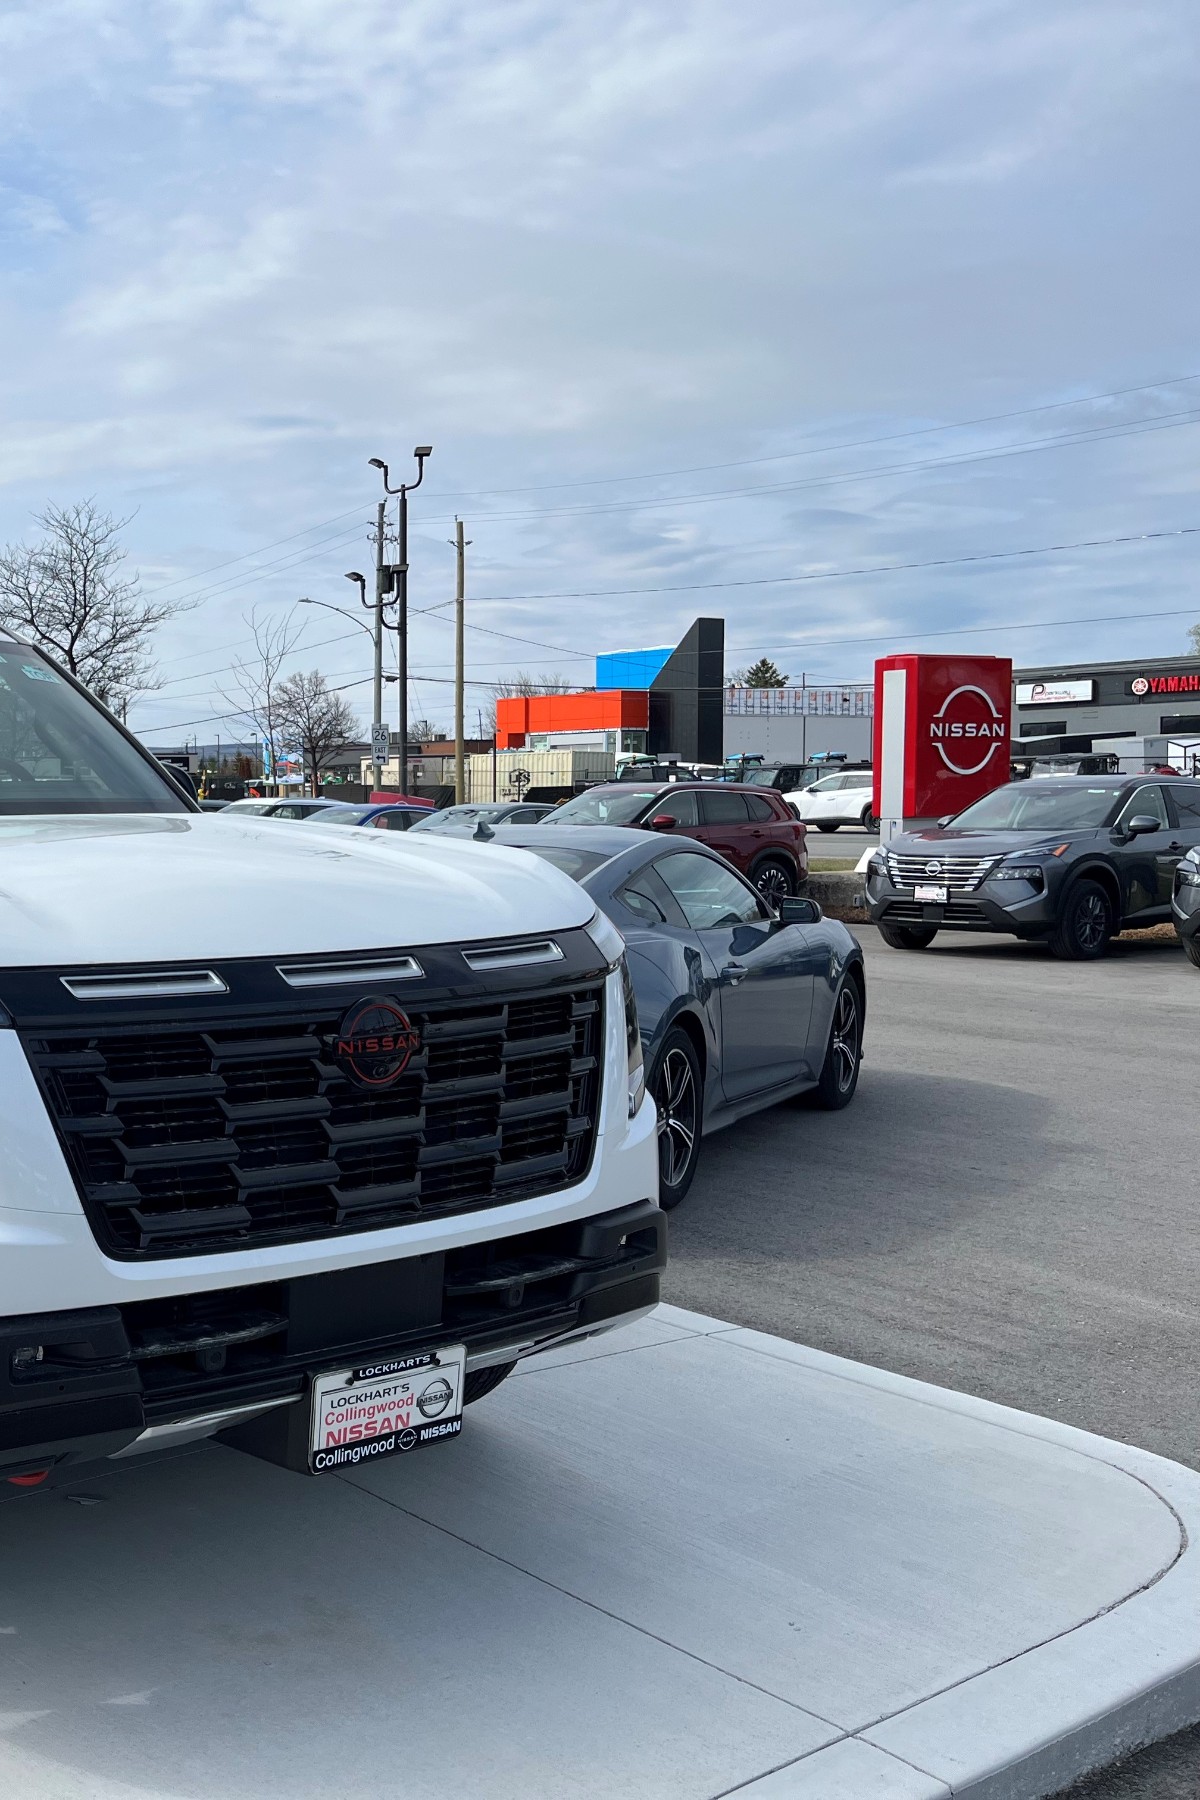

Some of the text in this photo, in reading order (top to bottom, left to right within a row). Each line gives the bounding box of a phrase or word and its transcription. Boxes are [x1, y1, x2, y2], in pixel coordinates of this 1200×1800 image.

[1149, 675, 1200, 693] YAMAH
[374, 730, 387, 741] 26
[930, 723, 1005, 737] NISSAN
[374, 746, 386, 754] EAST
[338, 1033, 419, 1054] NISSAN
[419, 1391, 449, 1405] NISSAN
[325, 1393, 415, 1426] Collingwood
[326, 1412, 410, 1448] NISSAN
[315, 1420, 461, 1469] Collingwood NISSAN
